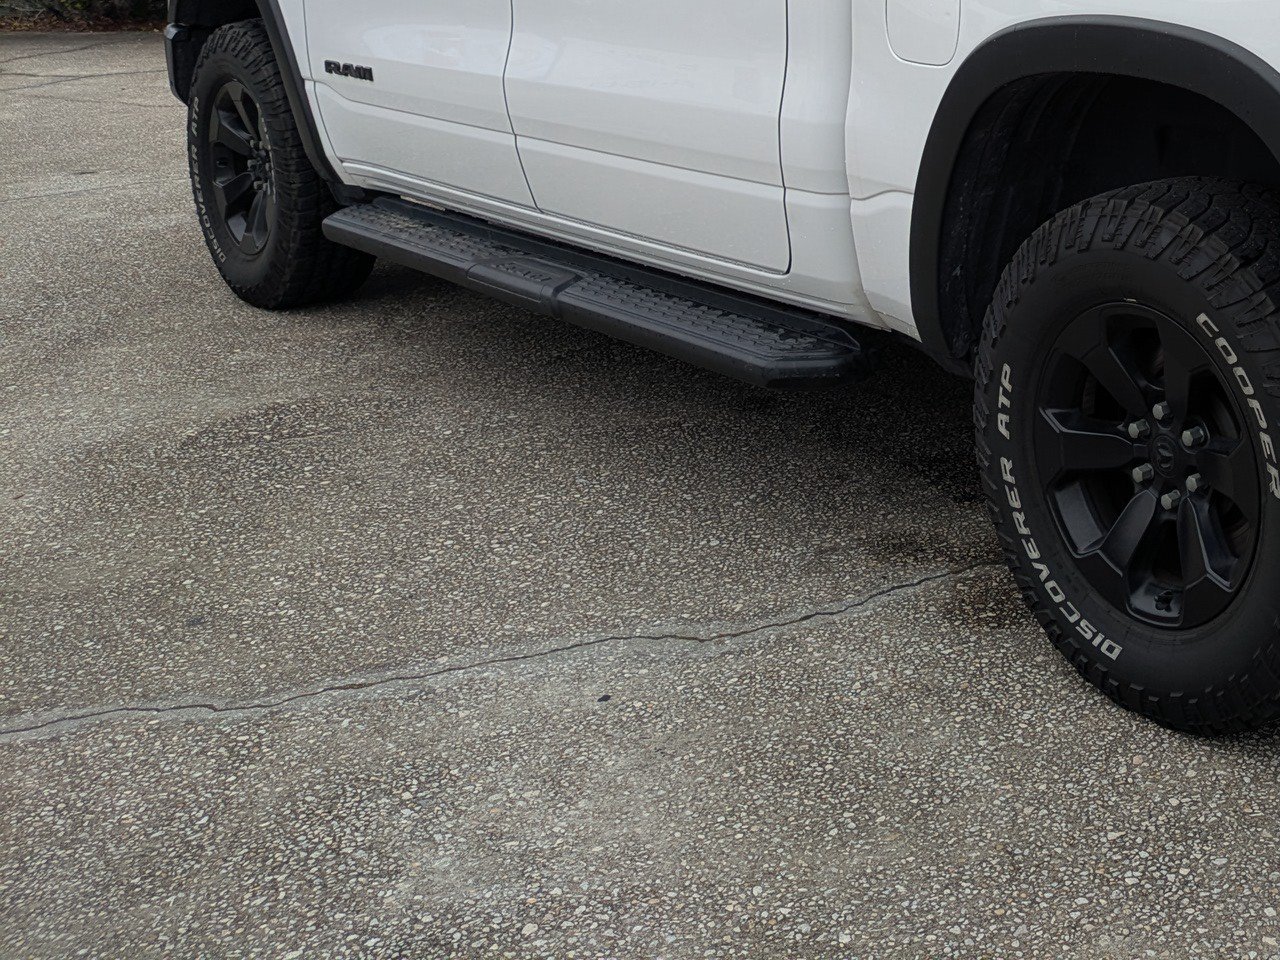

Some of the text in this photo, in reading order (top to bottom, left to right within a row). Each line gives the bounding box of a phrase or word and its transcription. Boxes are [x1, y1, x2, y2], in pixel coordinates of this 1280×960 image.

[324, 59, 374, 82] RAM
[1196, 312, 1280, 500] COOPER
[997, 362, 1123, 661] DISCOVERER ATP
